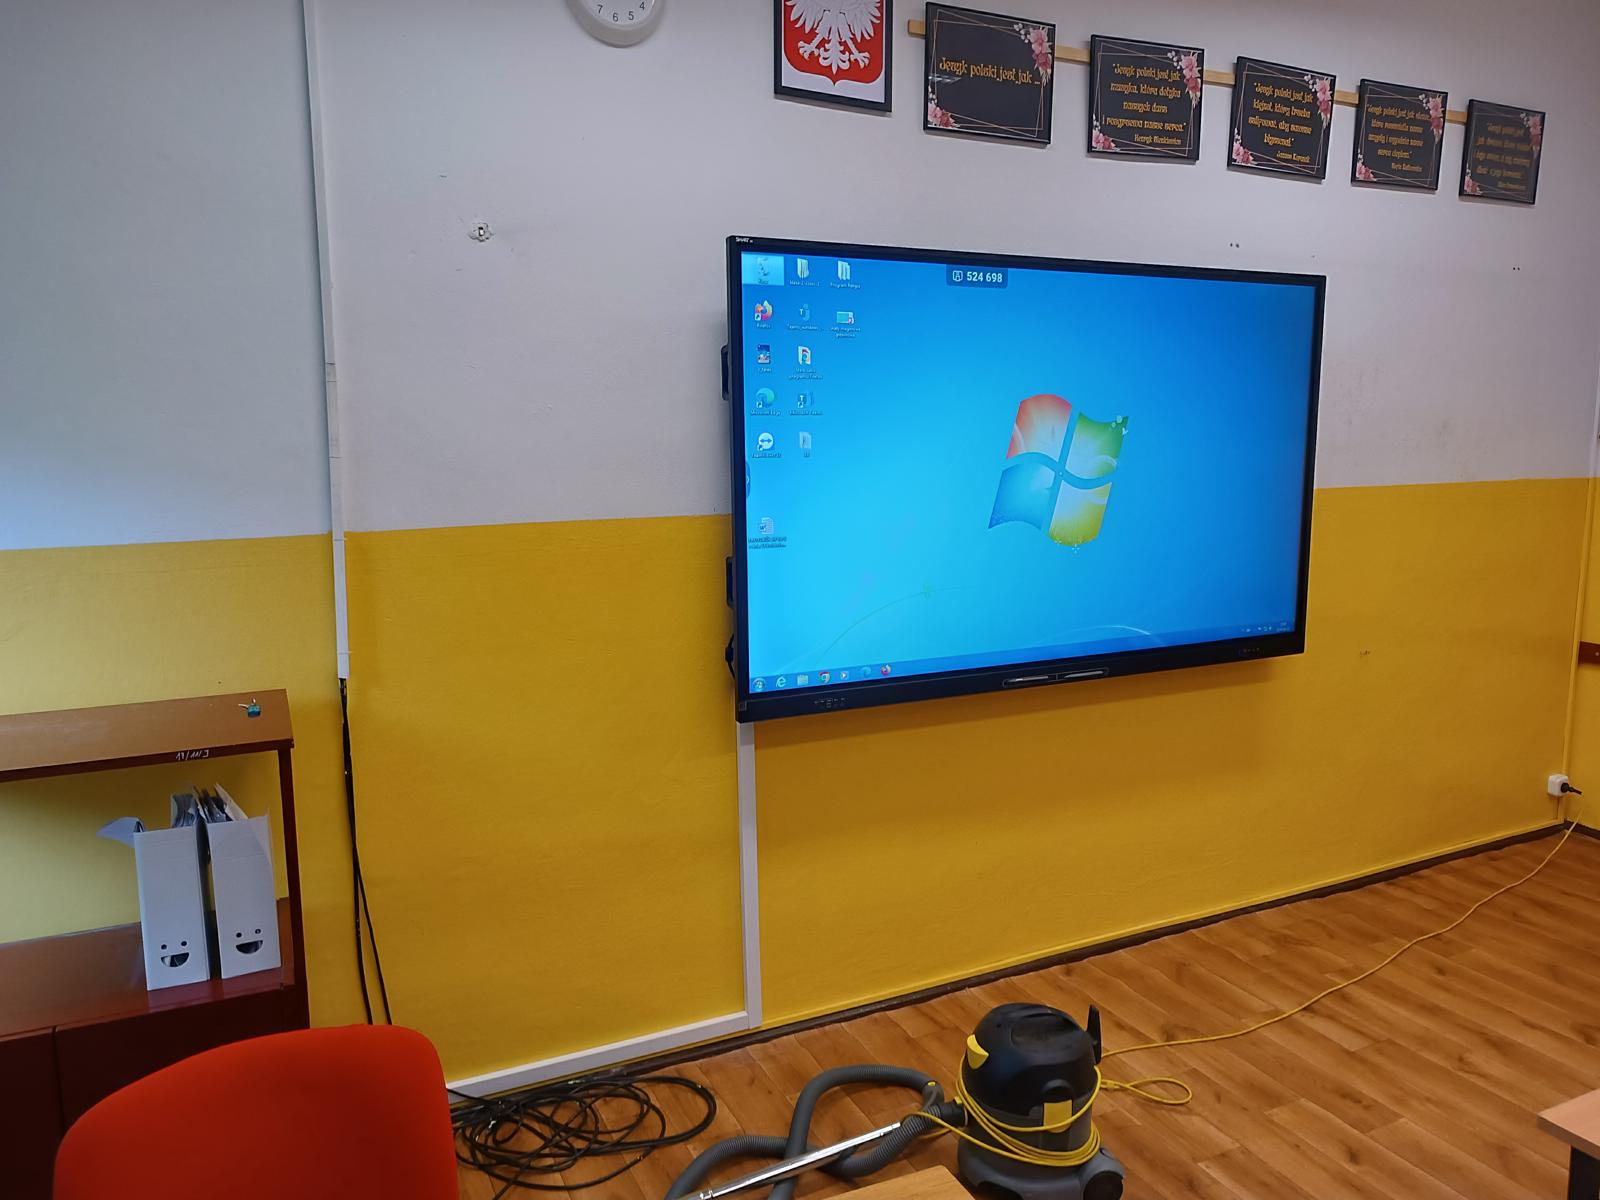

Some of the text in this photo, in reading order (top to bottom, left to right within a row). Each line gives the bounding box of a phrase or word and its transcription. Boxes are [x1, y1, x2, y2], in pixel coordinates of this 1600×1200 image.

[597, 4, 603, 14] 7
[639, 1, 645, 11] 4
[612, 12, 619, 22] 6
[628, 11, 635, 21] 5
[939, 57, 968, 75] Język
[970, 64, 997, 79] polski
[997, 66, 1016, 82] jest
[1016, 69, 1033, 84] jak
[1136, 67, 1156, 78] polski
[966, 271, 1003, 283] 524 698
